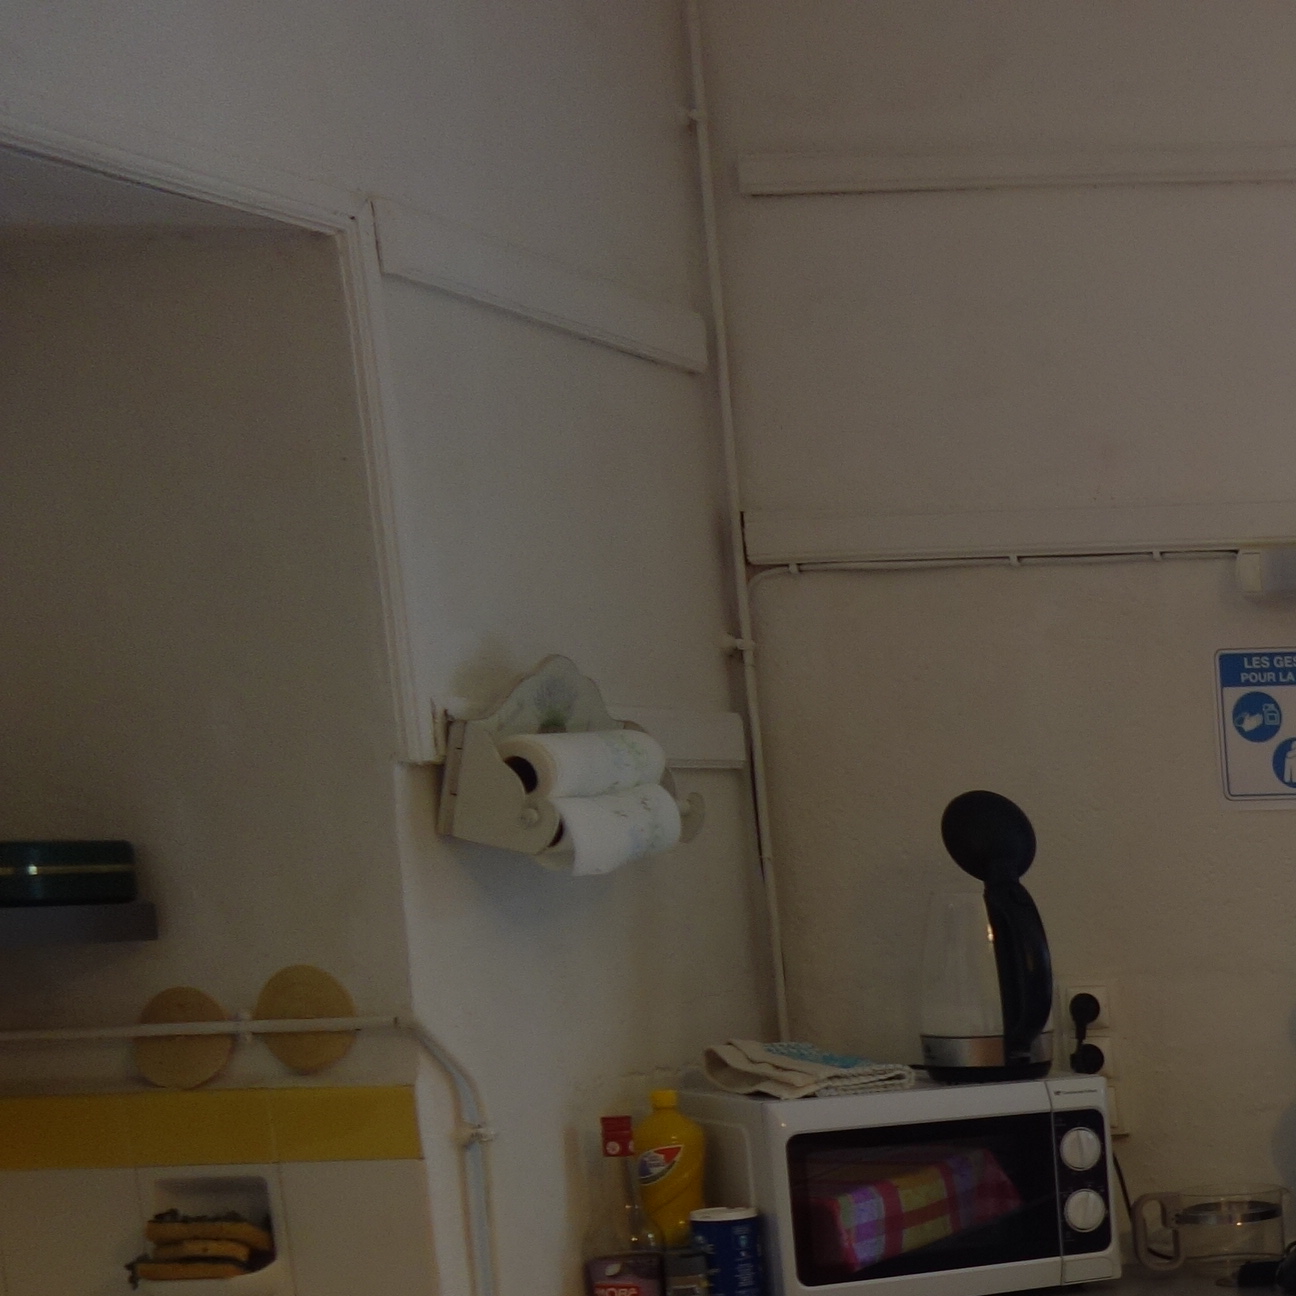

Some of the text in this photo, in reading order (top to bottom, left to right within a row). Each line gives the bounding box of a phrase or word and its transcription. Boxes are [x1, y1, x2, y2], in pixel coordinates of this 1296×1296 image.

[1244, 657, 1270, 668] LES
[1241, 672, 1276, 682] POUR
[1279, 671, 1295, 682] LA
